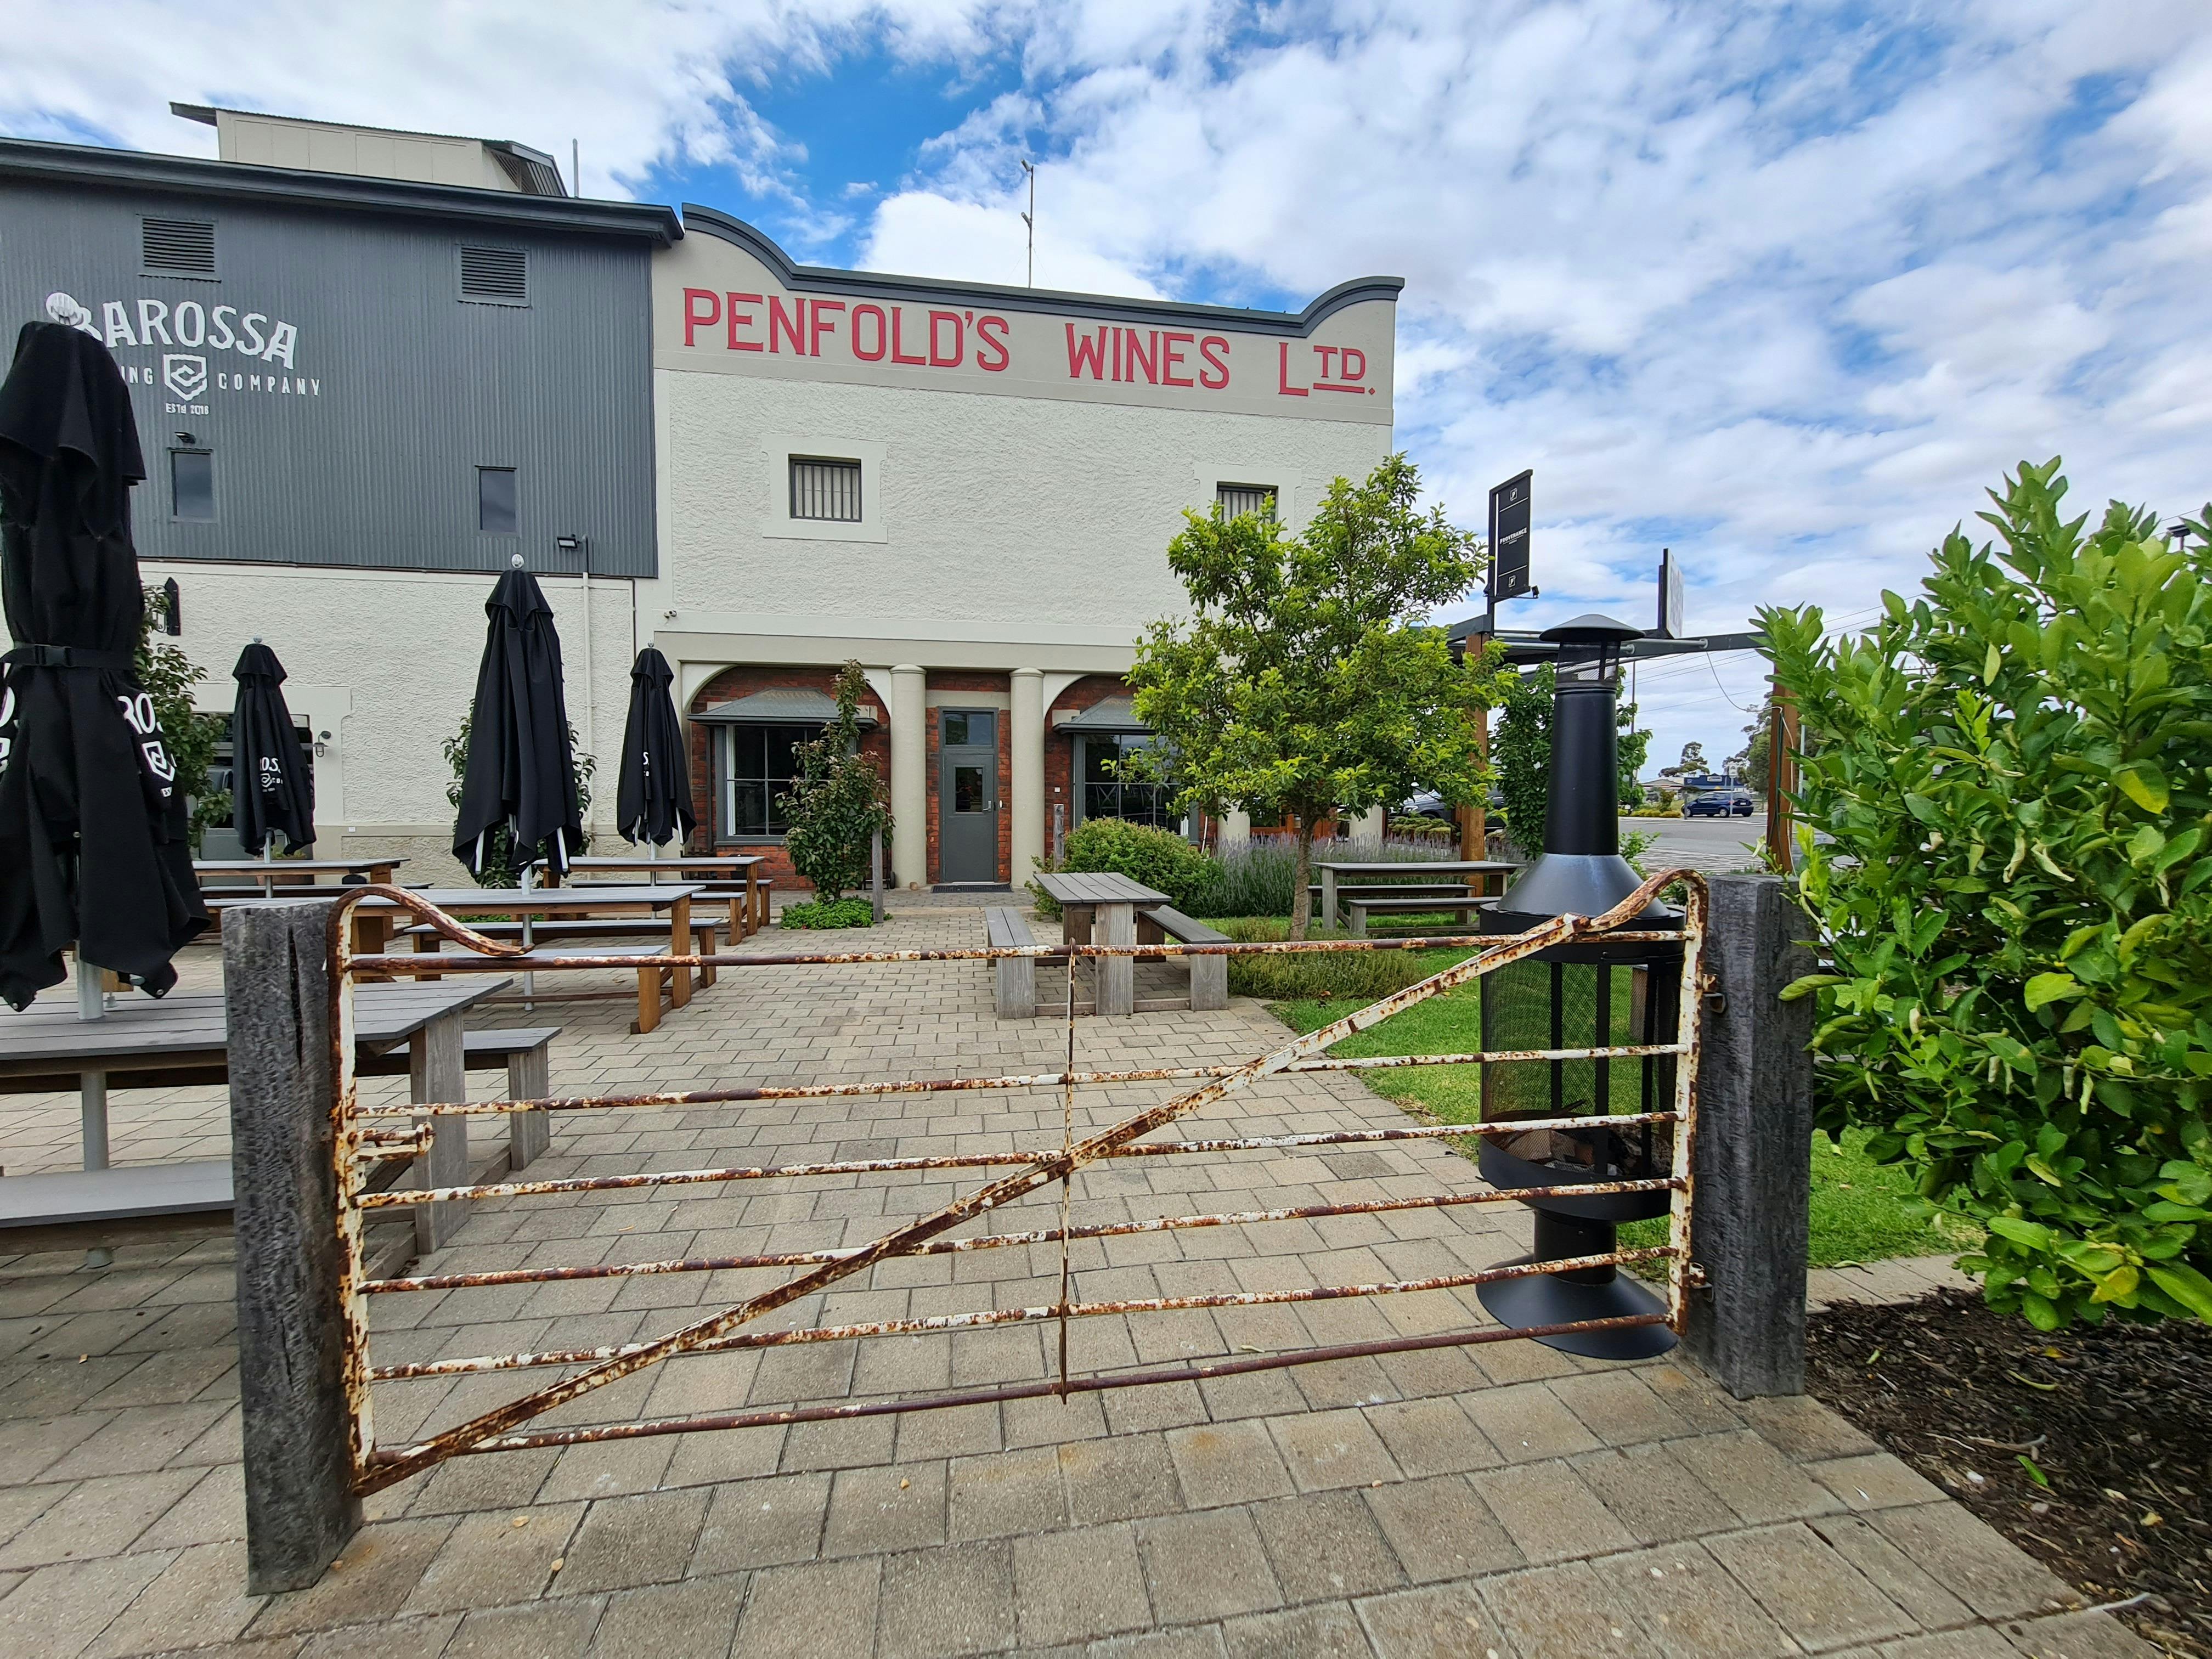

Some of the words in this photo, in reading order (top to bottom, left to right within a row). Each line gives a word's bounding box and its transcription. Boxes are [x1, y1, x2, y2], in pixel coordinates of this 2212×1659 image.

[682, 287, 1009, 371] PENFOLD'S
[1065, 323, 1230, 389] WINES
[218, 373, 320, 396] COMPANY
